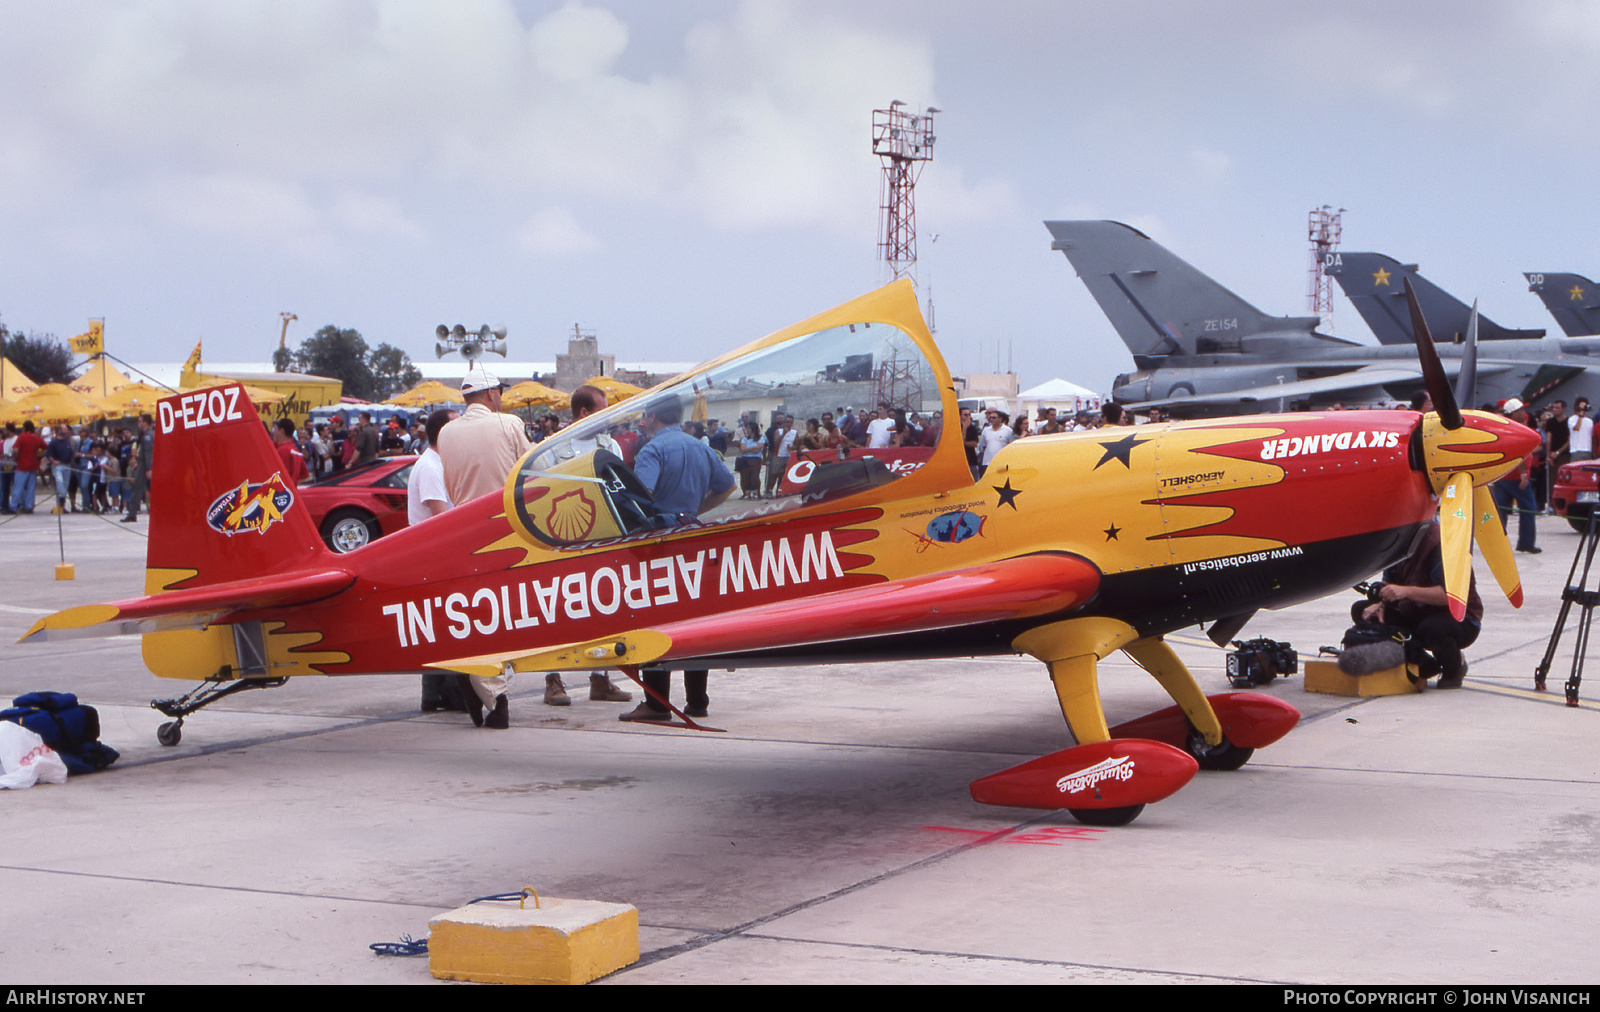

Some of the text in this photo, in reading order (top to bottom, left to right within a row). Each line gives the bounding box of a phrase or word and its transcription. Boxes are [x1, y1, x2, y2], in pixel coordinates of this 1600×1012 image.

[1326, 253, 1343, 266] DA
[1204, 318, 1238, 331] ZE154
[159, 387, 242, 434] D-EZOZ
[1260, 431, 1400, 460] SKYDANCER
[1161, 470, 1226, 487] AEROSHELL
[208, 491, 236, 520] SKYDANCER
[900, 509, 933, 518] Promotions
[1184, 546, 1304, 575] www.aerobatics.nl
[383, 531, 845, 648] WWW.AEROBATICS.NL
[1060, 761, 1135, 793] Blundstone
